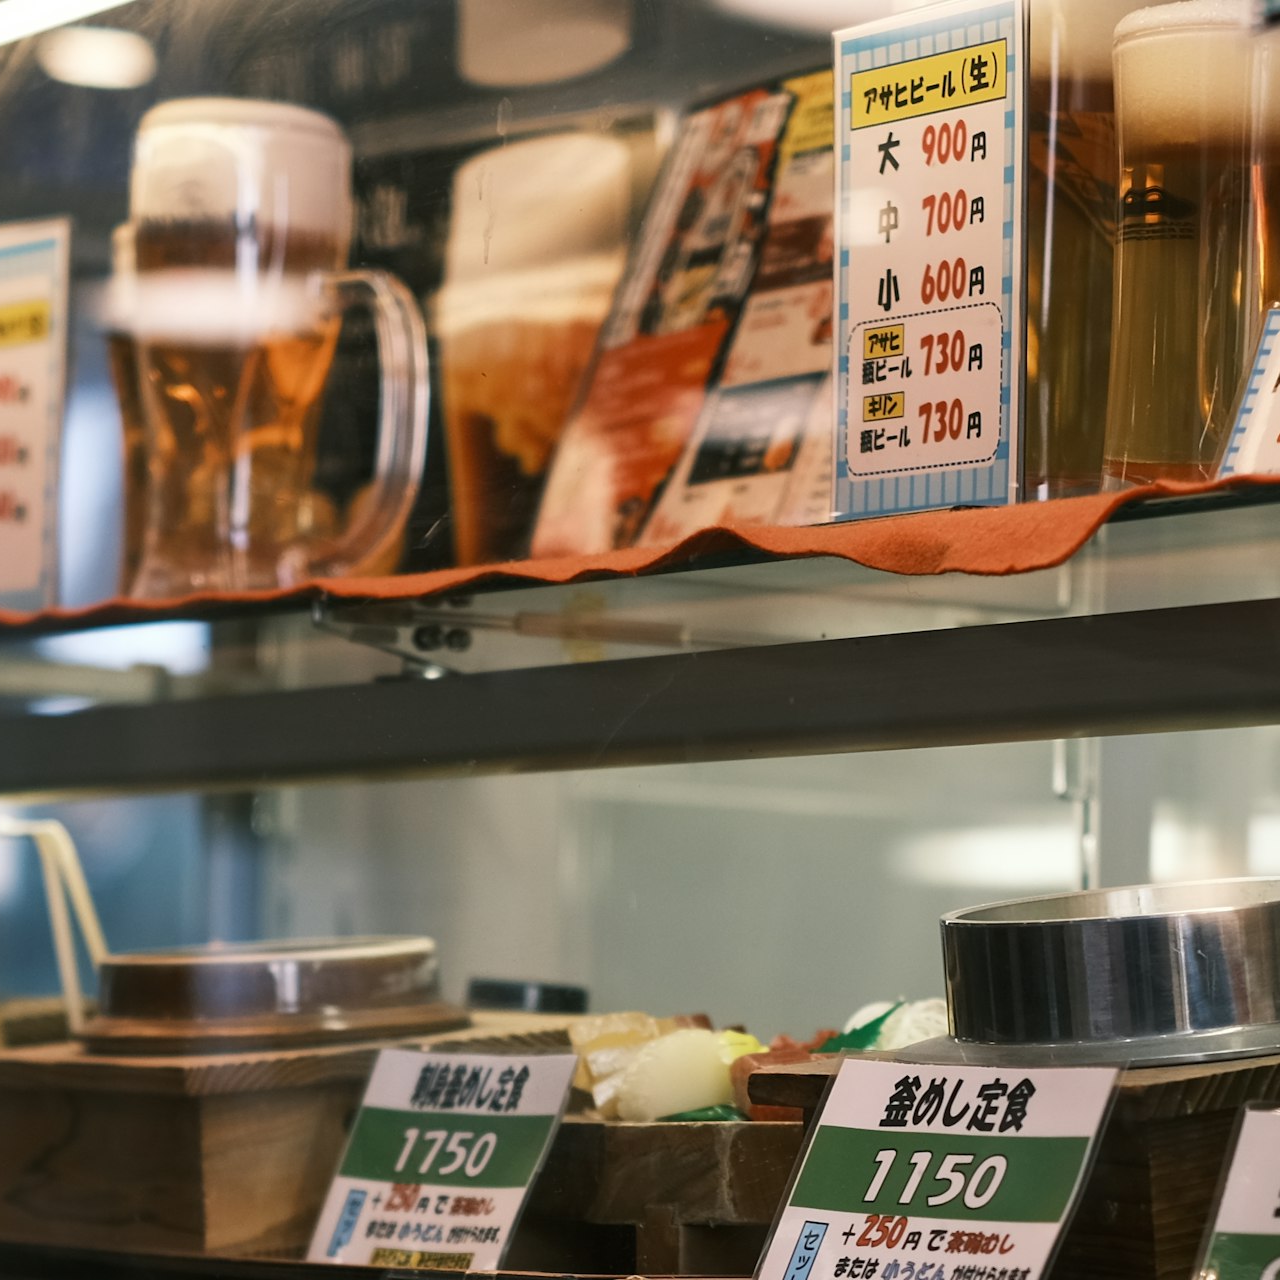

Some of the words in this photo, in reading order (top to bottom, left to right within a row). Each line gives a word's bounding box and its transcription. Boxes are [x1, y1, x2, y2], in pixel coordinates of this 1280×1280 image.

[864, 52, 998, 114] アサヒビール(生)
[878, 131, 901, 175] 大
[922, 119, 987, 166] 900円
[878, 200, 899, 244] 中
[922, 188, 985, 237] 700円
[877, 268, 900, 312] 小
[921, 257, 985, 305] 600円
[868, 332, 900, 354] アサヒ
[920, 329, 983, 377] 730円
[867, 395, 898, 417] キリン
[918, 398, 982, 445] 730円
[879, 1075, 1037, 1133] 釜めし定食
[394, 1127, 498, 1178] 1750
[862, 1148, 1009, 1209] 1150
